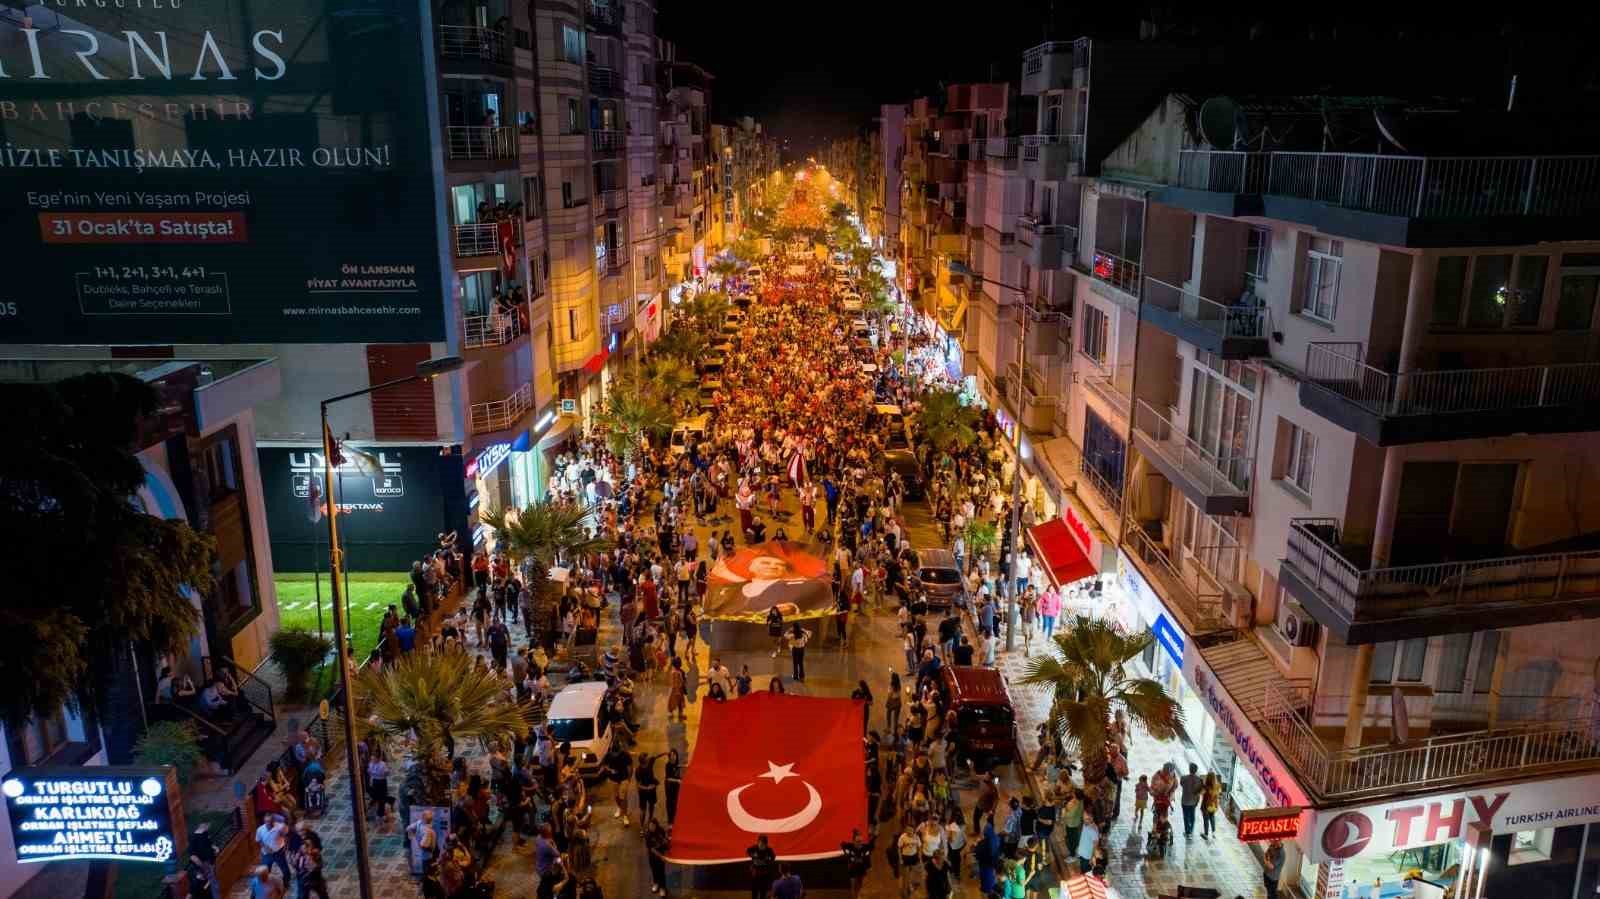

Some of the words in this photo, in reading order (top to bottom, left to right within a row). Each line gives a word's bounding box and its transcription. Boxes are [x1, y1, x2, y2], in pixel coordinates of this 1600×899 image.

[0, 142, 63, 168] İZLE
[68, 148, 221, 174] TANIŞMAYA,
[227, 148, 303, 167] HAZIR
[312, 144, 391, 167] OLUN!
[94, 190, 130, 205] Yeni
[134, 191, 190, 208] Yaşam
[194, 190, 250, 208] Projesi
[51, 219, 73, 235] 31
[159, 219, 233, 239] Satışta!
[95, 266, 120, 280] 1+1,
[122, 266, 148, 280] 2+1,
[151, 266, 177, 280] 3+1,
[181, 266, 205, 280] 4+1
[341, 263, 358, 274] ÖN
[360, 265, 416, 274] LANSMAN
[340, 279, 417, 288] AVANTAJIYLA
[33, 781, 132, 795] TURGUTLU
[34, 804, 140, 820] KARLIKDAĞ
[1504, 811, 1553, 826] TURKISH
[1242, 817, 1300, 835] PEGASUS
[1388, 792, 1511, 849] THY
